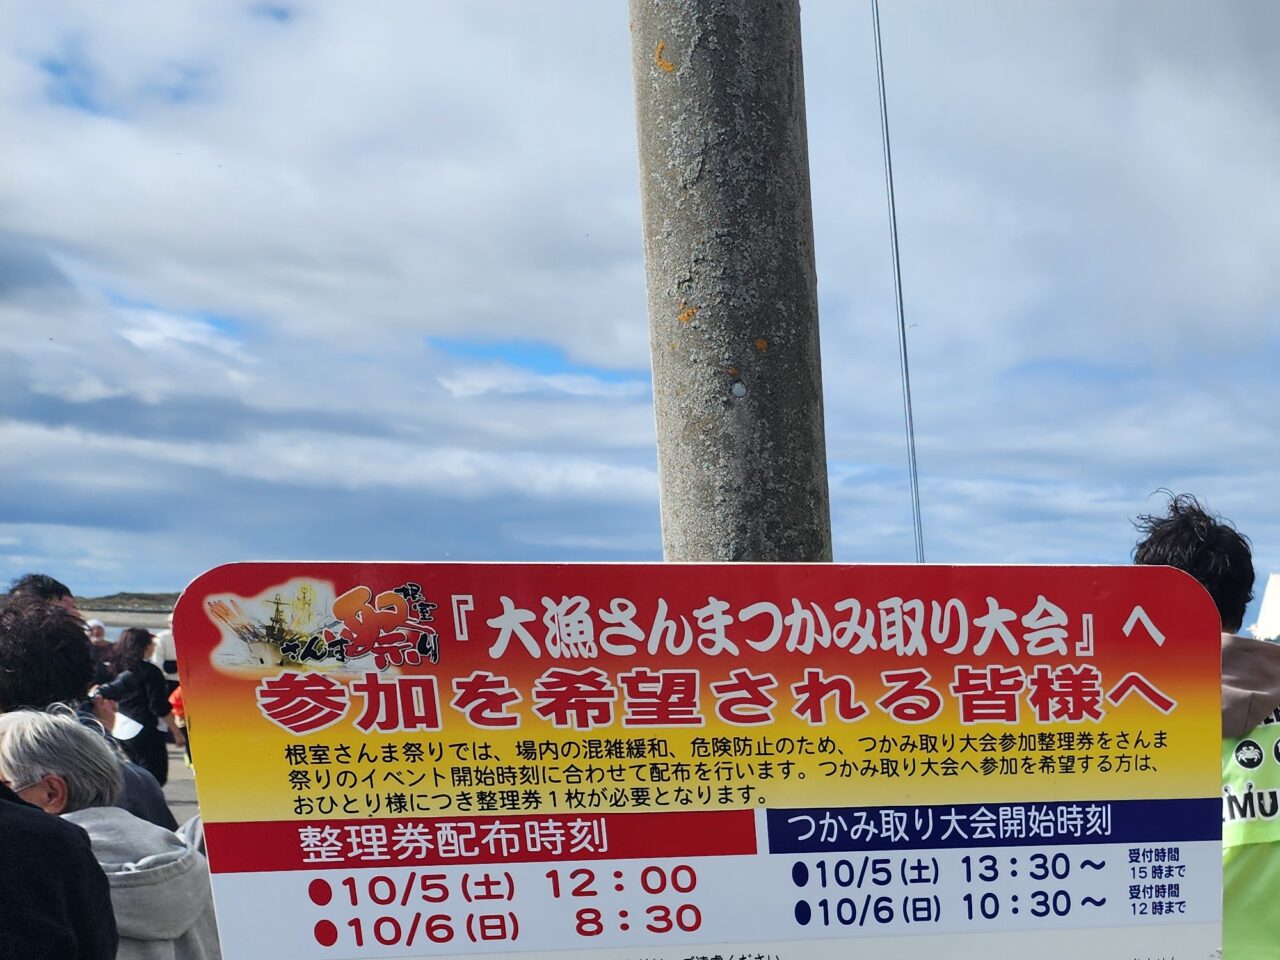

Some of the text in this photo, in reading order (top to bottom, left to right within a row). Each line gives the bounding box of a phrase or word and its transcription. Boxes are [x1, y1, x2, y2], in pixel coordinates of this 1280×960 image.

[256, 664, 1178, 735] 参加を希望される皆様へ
[285, 731, 1168, 766] 根室さんま祭りでは、場内の混雑緩和、危険防止のため、つかみ取り大会参加整理券をさんま
[288, 755, 1160, 791] 祭りのイベント開始時刻に合わせて配布を行います。つかみ取り大会へ参加を希望する方は、
[299, 817, 608, 864] 整理券配布時刻
[788, 804, 1112, 842] つかみ取り大会開始時刻
[1128, 848, 1180, 864] 受付時間
[1131, 864, 1186, 880] 15時まで
[1128, 883, 1180, 899] 受付時間
[1132, 900, 1186, 916] 12時まで
